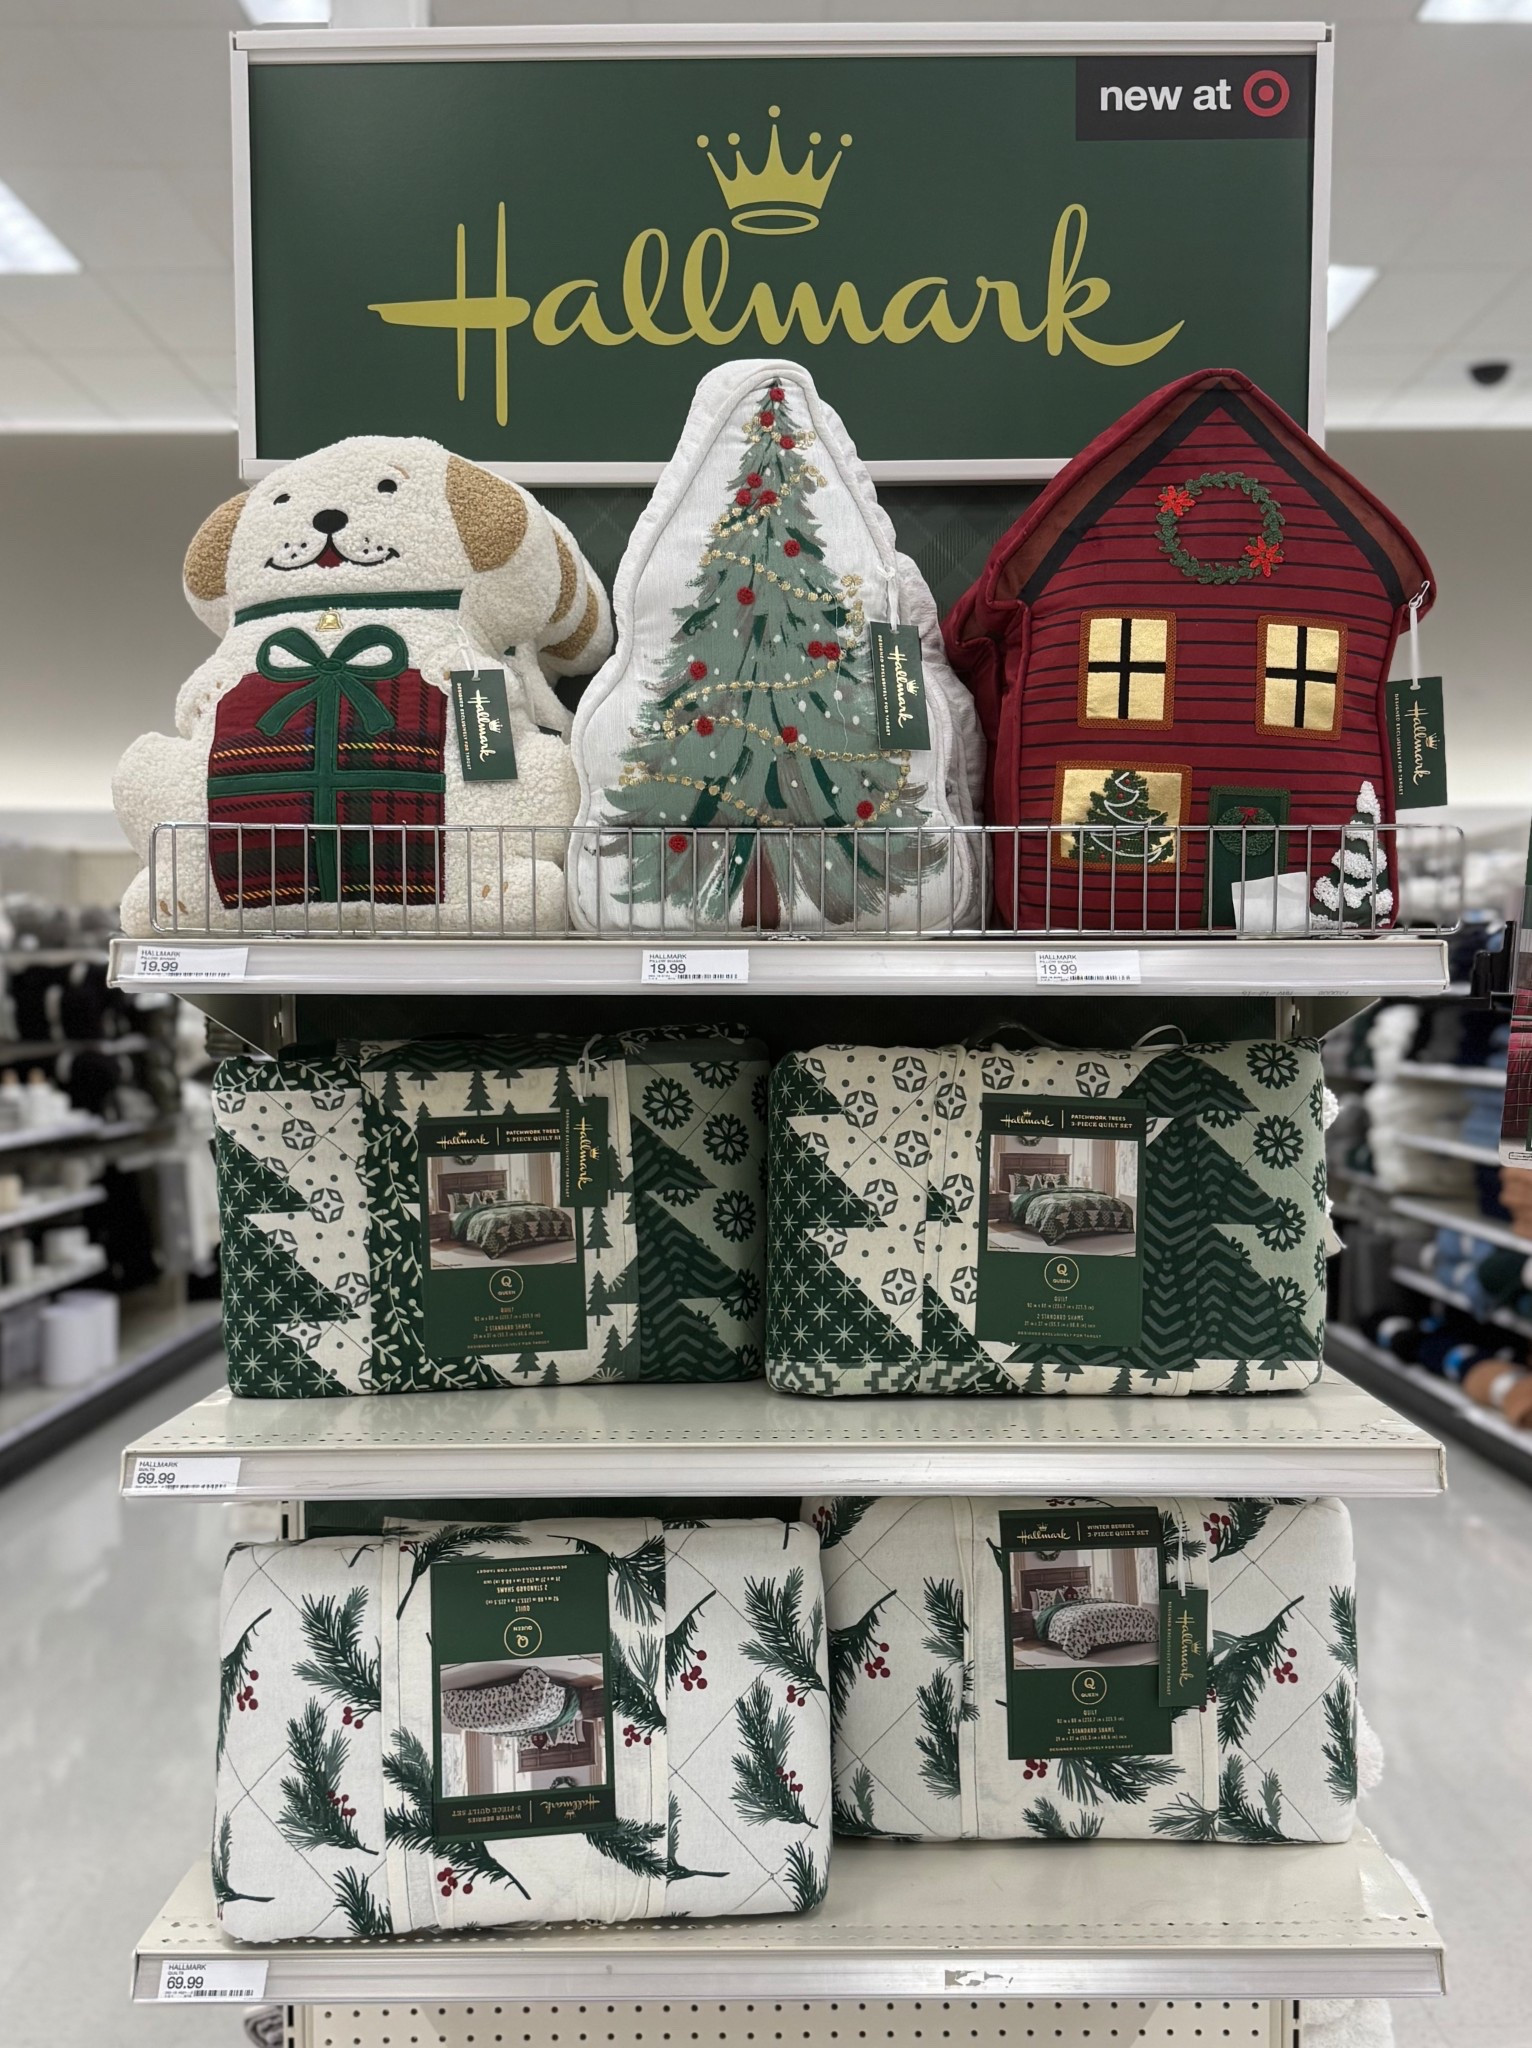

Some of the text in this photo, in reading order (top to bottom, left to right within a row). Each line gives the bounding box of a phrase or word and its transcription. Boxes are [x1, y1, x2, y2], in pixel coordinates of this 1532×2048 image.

[1100, 79, 1231, 111] new at
[367, 202, 1184, 426] Hallmark
[887, 645, 913, 728] Hallmark
[467, 690, 496, 762] Hallmark
[1404, 700, 1431, 785] Hallmark
[141, 961, 178, 972] 19.99
[650, 964, 686, 973] 19.99
[1041, 964, 1077, 974] 19.99
[1000, 1114, 1054, 1128] Hallmark
[436, 1131, 490, 1149] Hallmark
[573, 1117, 593, 1190] Hallmark
[1057, 1263, 1068, 1276] Q
[501, 1276, 512, 1287] Q
[137, 1473, 175, 1484] 69.99
[1017, 1528, 1071, 1544] Hallmark
[516, 1634, 529, 1648] Q
[1175, 1610, 1195, 1687] Hallmark
[1084, 1678, 1095, 1689] Q
[540, 1793, 600, 1814] Hallmark
[468, 1807, 490, 1815] QUILT
[167, 1976, 204, 1989] 69.99
